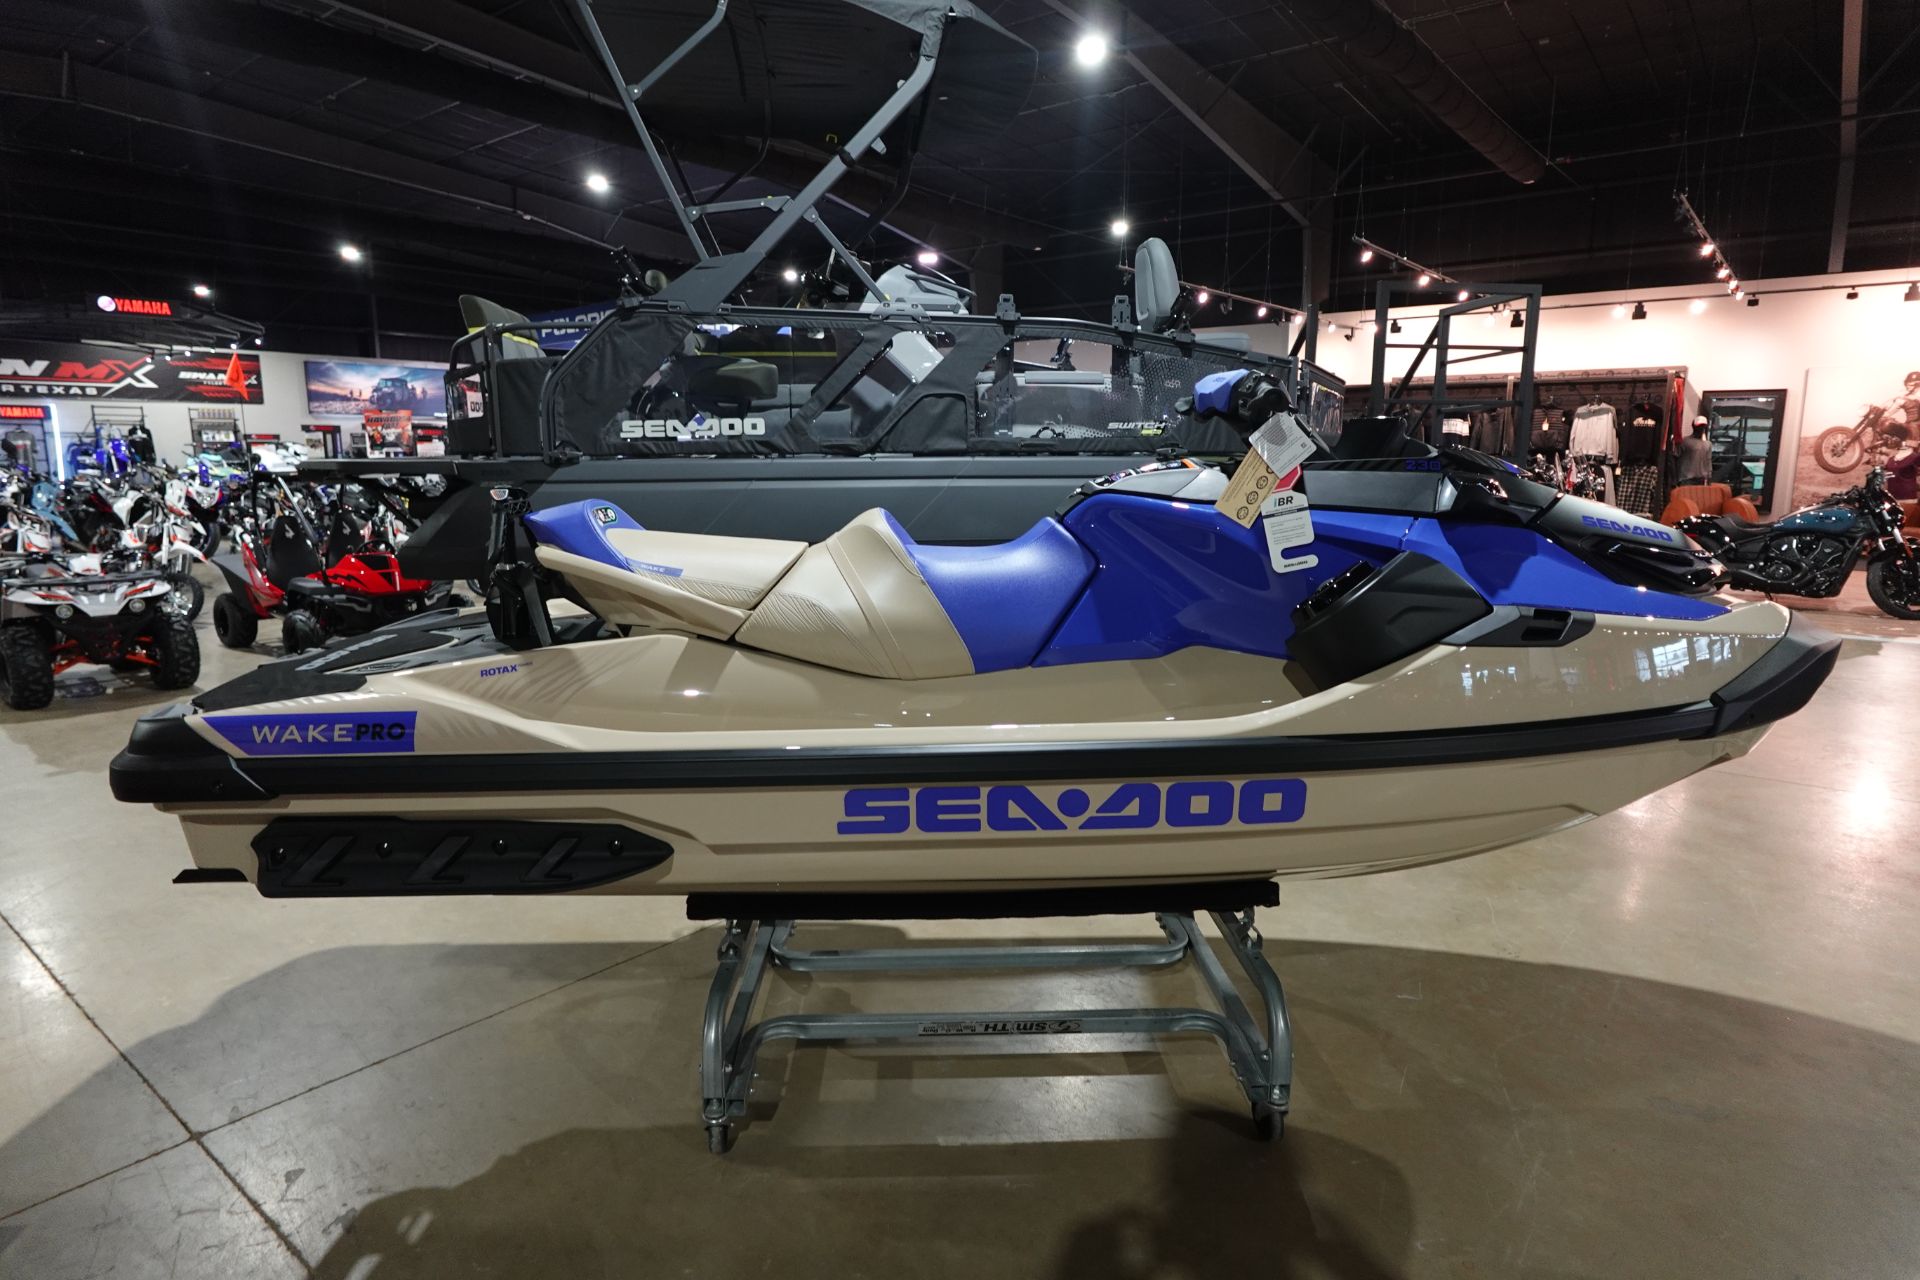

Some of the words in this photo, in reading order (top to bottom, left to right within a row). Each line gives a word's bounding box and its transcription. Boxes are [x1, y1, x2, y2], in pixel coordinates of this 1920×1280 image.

[114, 298, 172, 316] YAMAHA
[20, 385, 98, 396] TEXAS
[0, 406, 45, 418] YAMAHA
[480, 664, 518, 677] ROTAX
